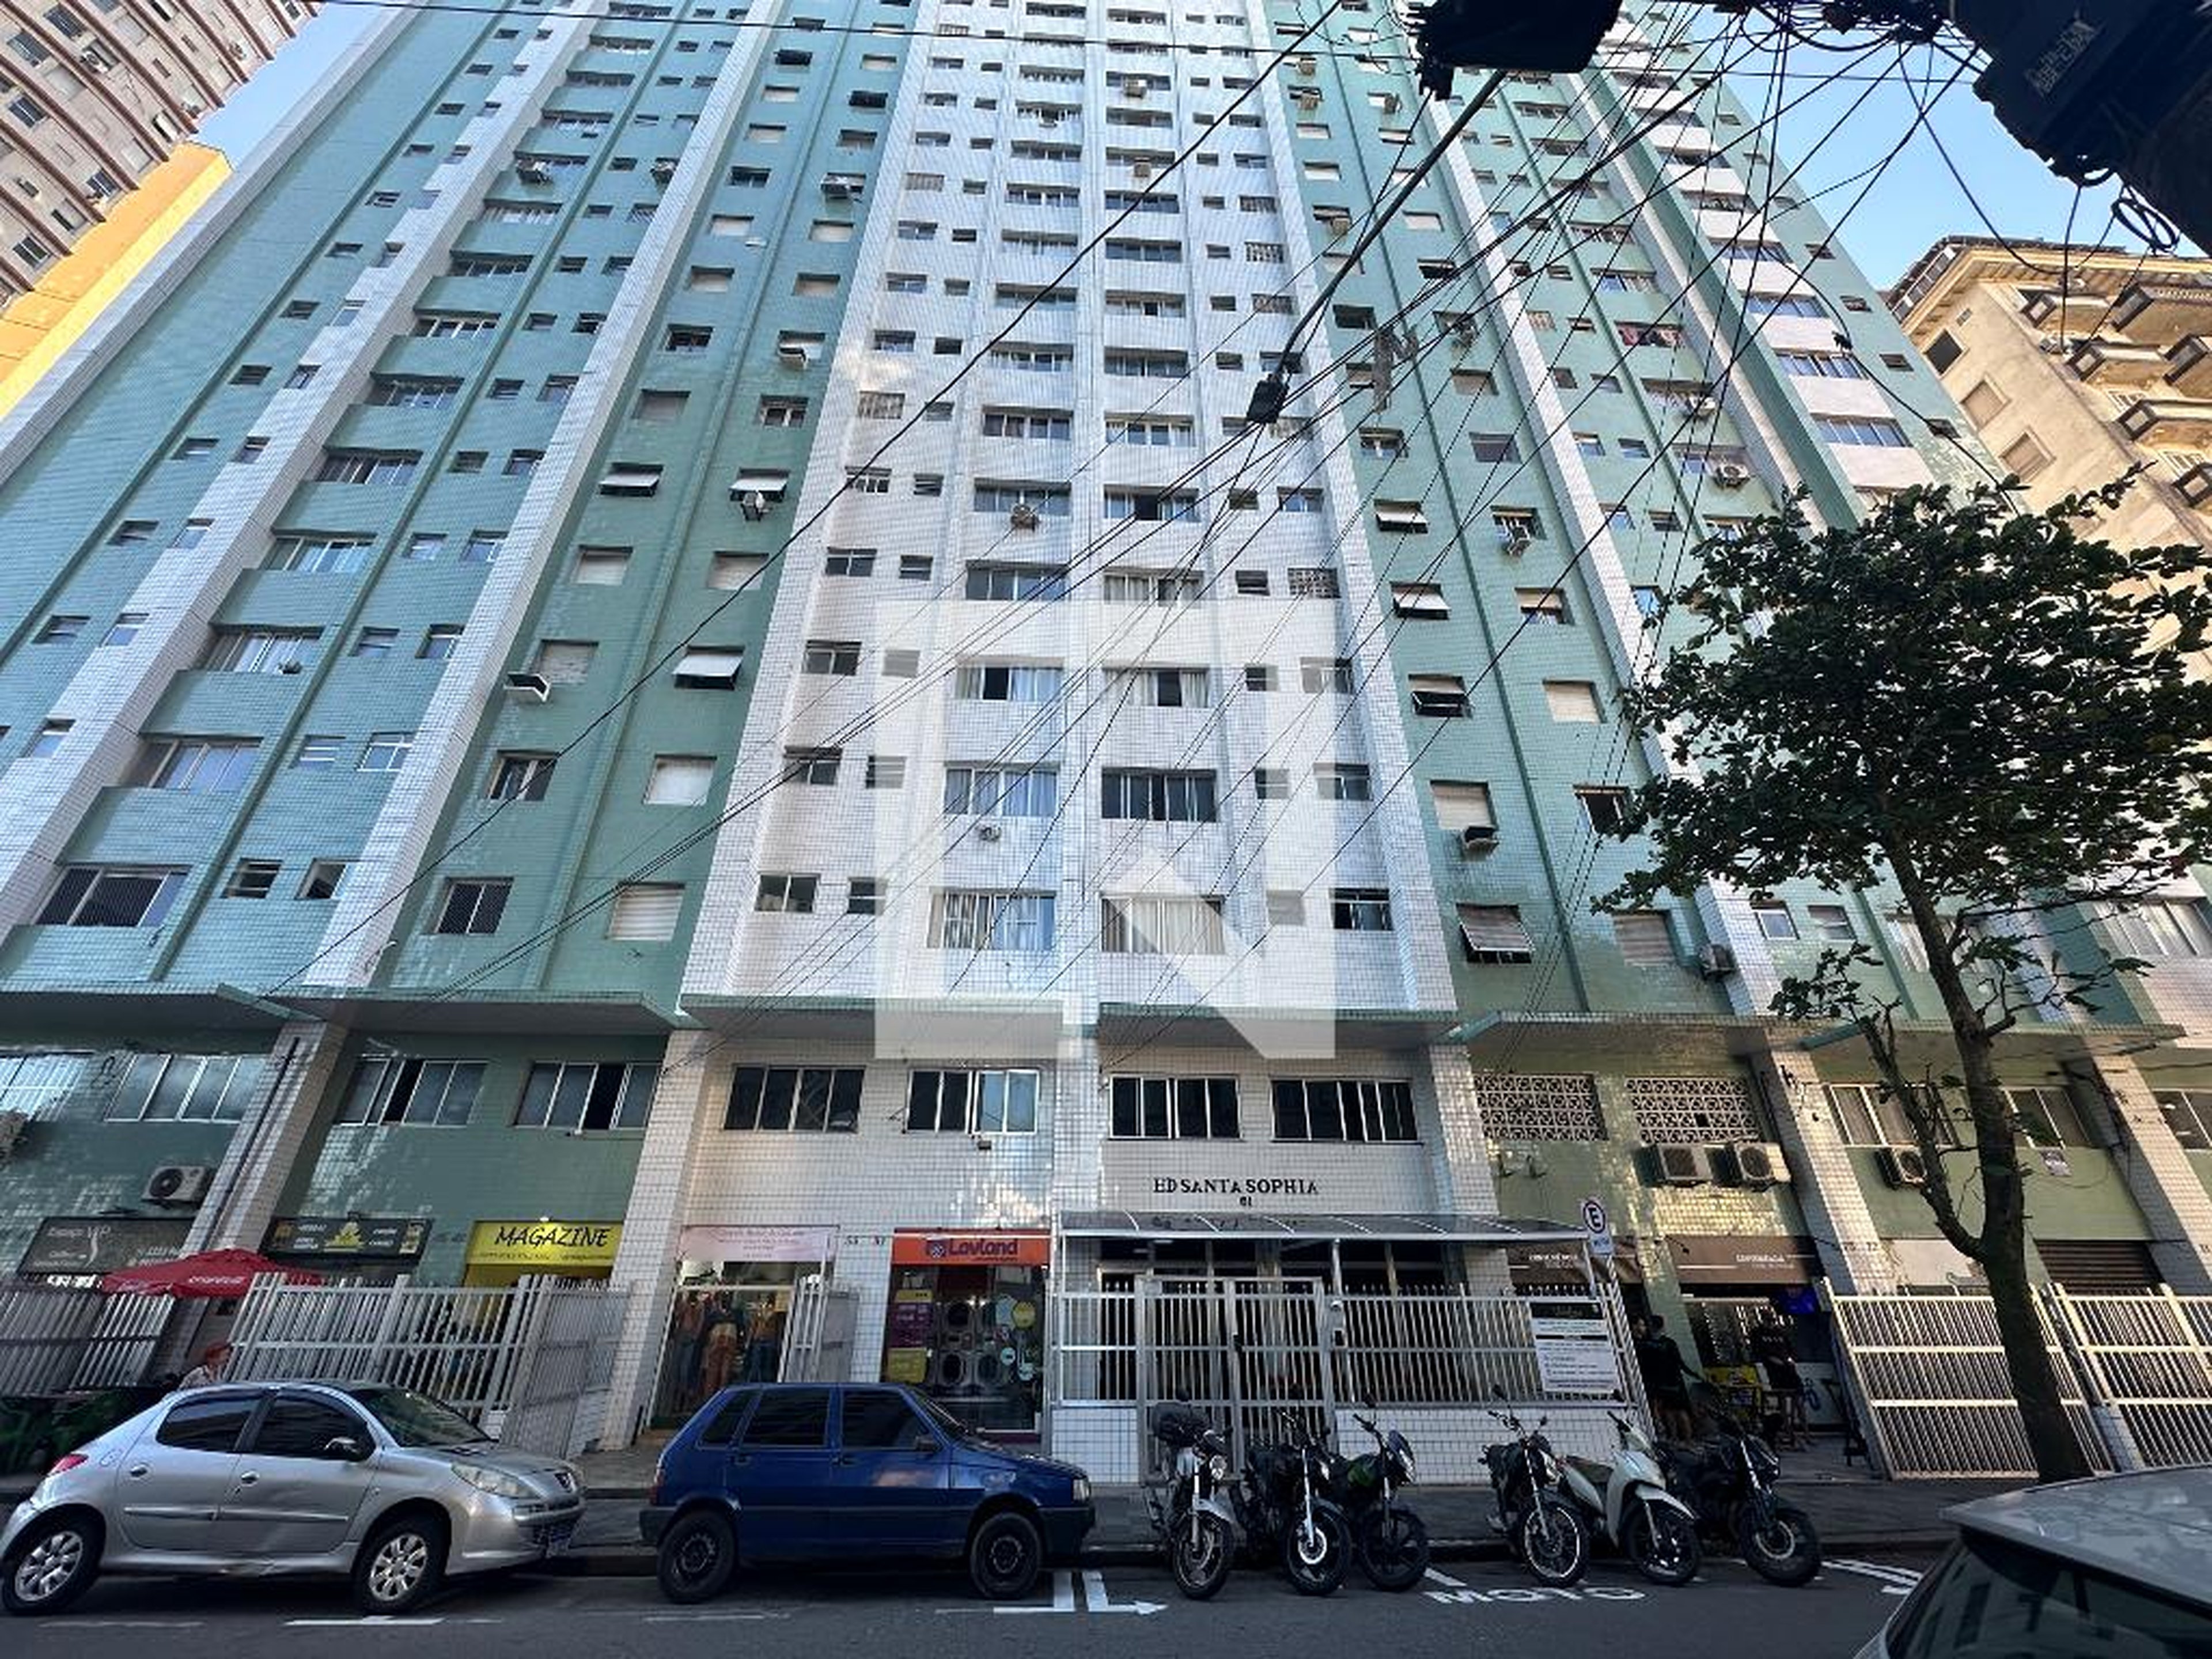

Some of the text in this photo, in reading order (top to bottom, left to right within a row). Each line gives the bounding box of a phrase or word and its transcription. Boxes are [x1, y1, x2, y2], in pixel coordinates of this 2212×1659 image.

[1153, 1177, 1319, 1194] ED SANTA SOPHIA
[1588, 1207, 1601, 1228] E
[494, 1225, 612, 1248] MAGAZINE
[949, 1238, 1018, 1255] Lavland
[1423, 1586, 1646, 1604] MOTO
